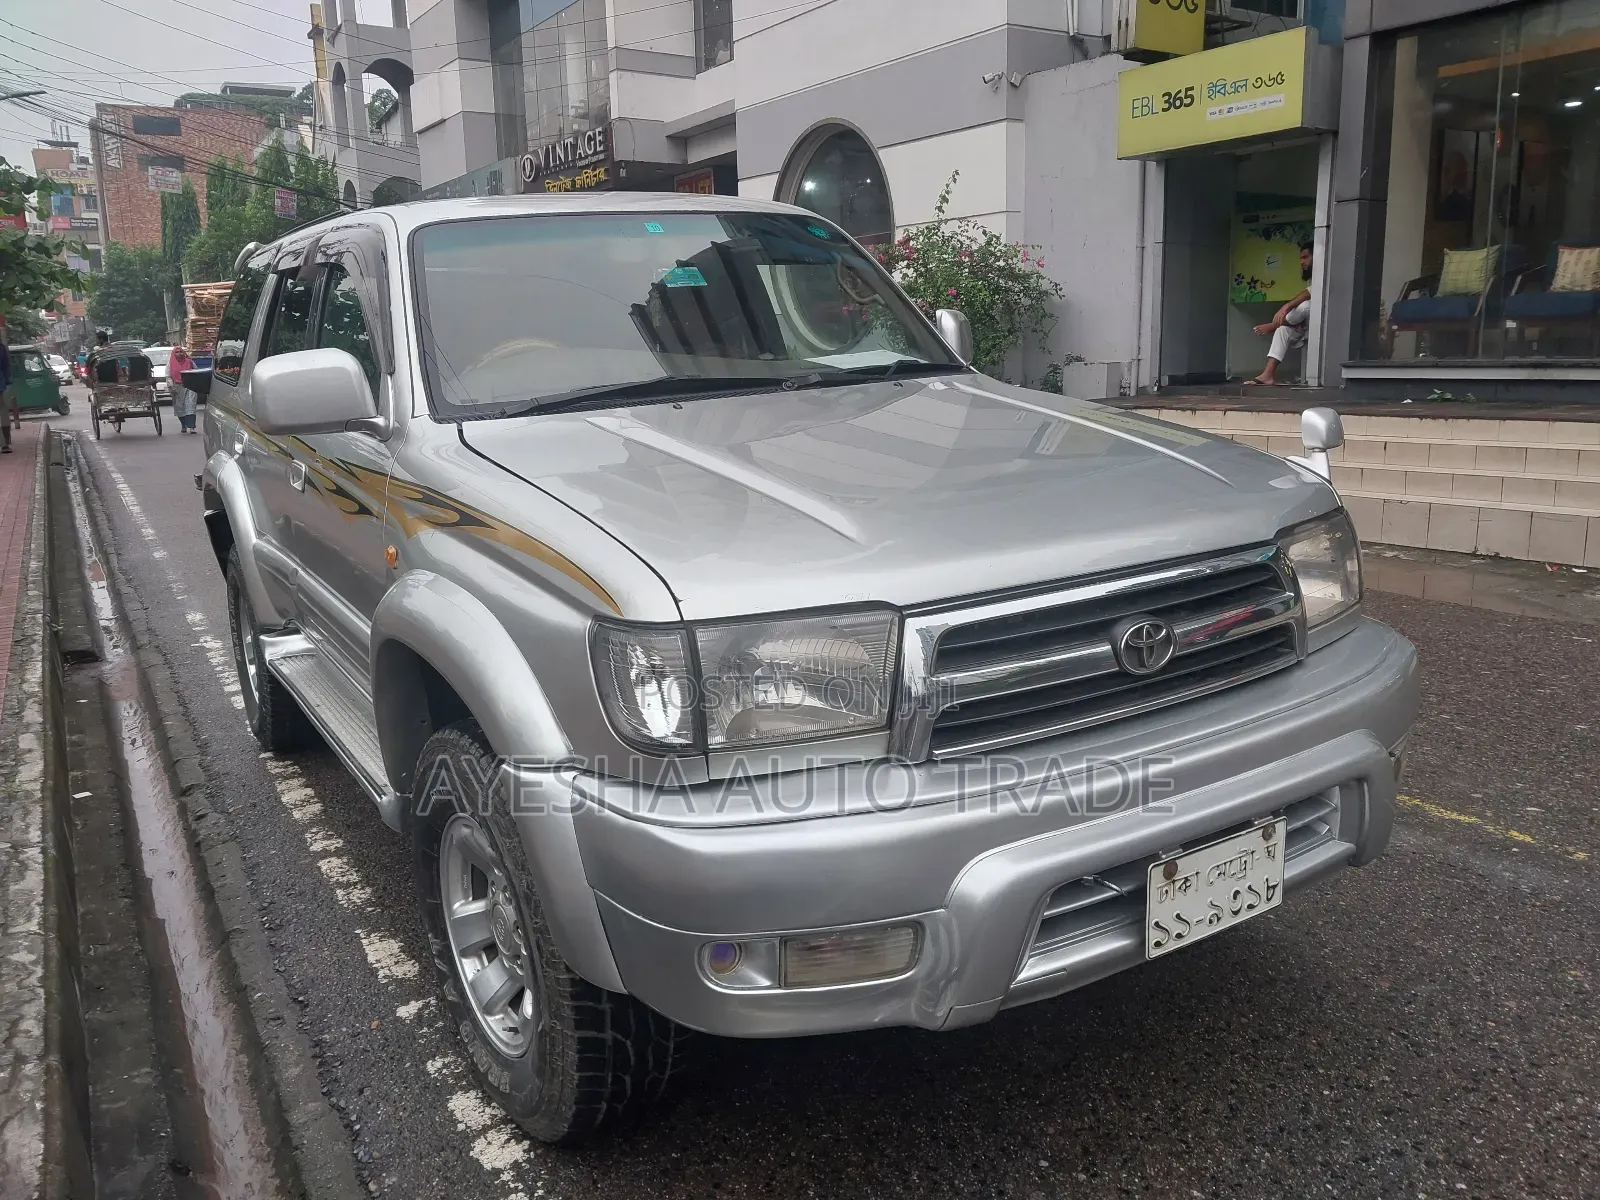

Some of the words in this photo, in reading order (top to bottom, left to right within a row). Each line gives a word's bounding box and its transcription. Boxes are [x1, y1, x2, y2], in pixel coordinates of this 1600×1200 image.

[1131, 95, 1159, 119] EBL
[1161, 86, 1195, 112] 365
[1206, 77, 1249, 101] ইবিএল
[1252, 70, 1286, 90] ৩৬৫
[538, 127, 604, 168] VINTAGE
[1156, 868, 1201, 904] ঢাকা
